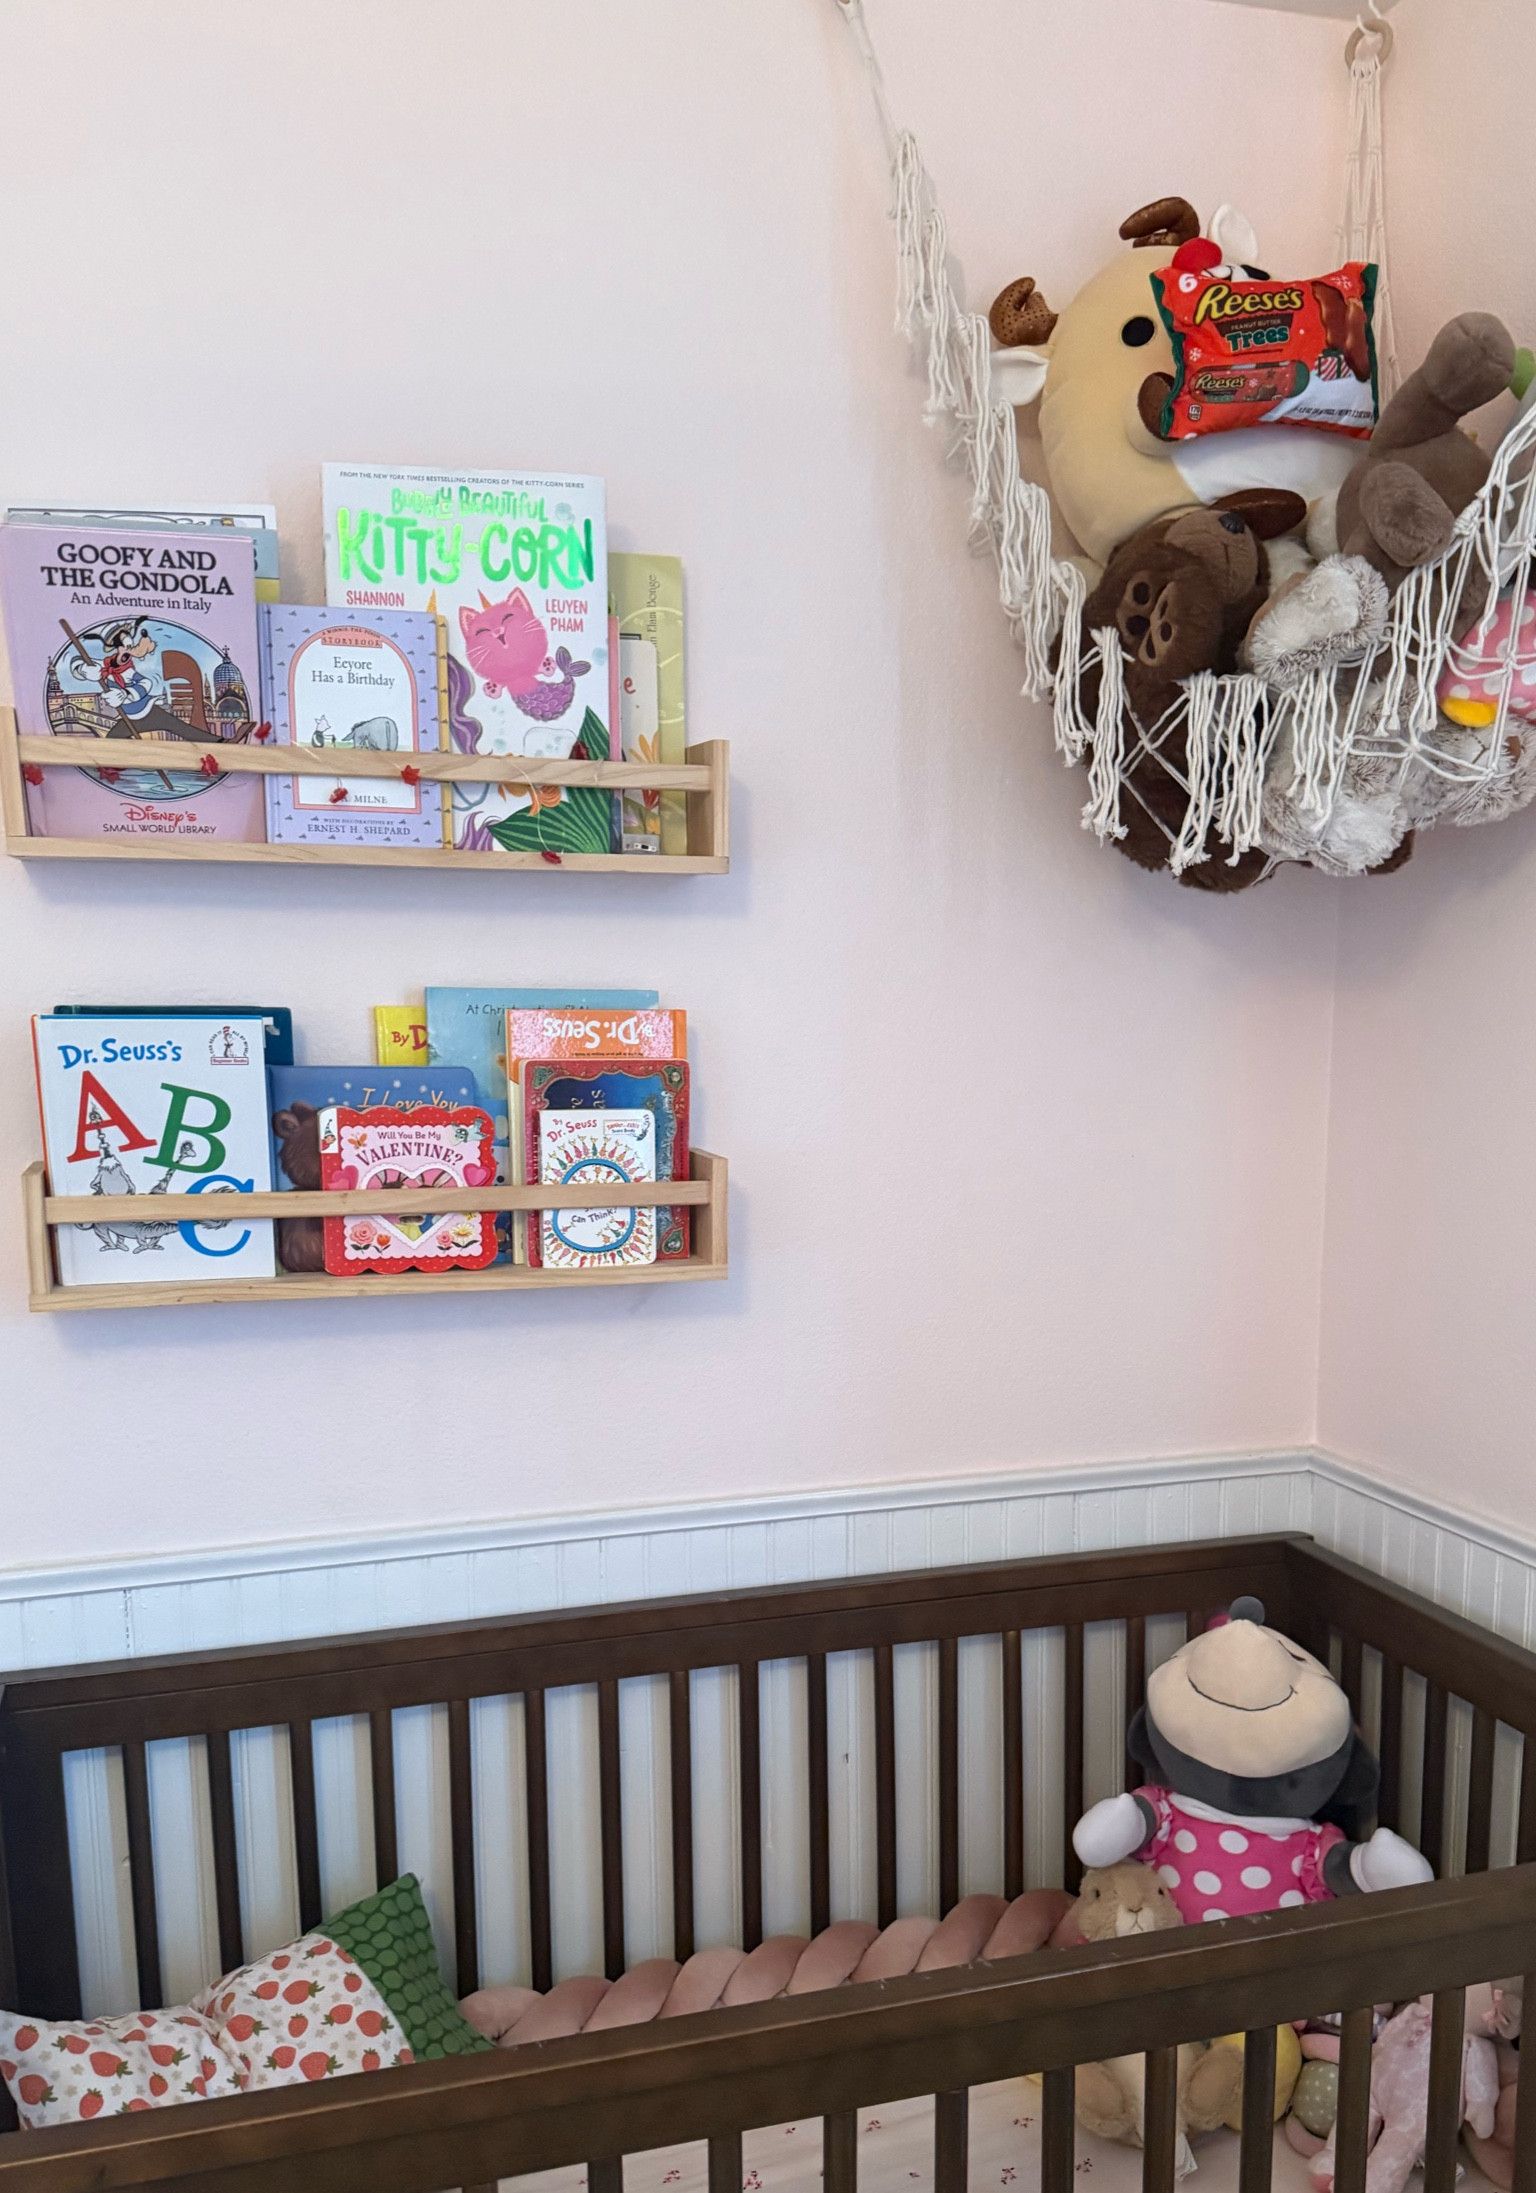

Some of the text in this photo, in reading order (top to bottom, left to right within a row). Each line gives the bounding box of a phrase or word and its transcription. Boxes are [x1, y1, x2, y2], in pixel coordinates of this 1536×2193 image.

[1178, 273, 1198, 293] 6
[1230, 319, 1282, 330] PEANUT BUTTER
[1225, 325, 1290, 353] Trees
[57, 543, 217, 571] GOOFY AND
[40, 566, 235, 596] THE GONDOLA
[70, 592, 212, 614] An Adventure in Italy
[346, 590, 405, 607] SHANNON
[545, 599, 588, 614] LEUYEN
[550, 617, 584, 632] PHAM
[322, 636, 381, 646] STORYBOOK
[333, 656, 373, 672] Eeyore
[312, 670, 396, 689] Has a Birthday
[353, 795, 388, 804] MILNE
[102, 823, 217, 834] SMALL WORLD LIBRARY
[307, 824, 347, 833] ERNEST
[363, 826, 411, 836] SHEPARD
[465, 1004, 479, 1015] At
[391, 1031, 409, 1047] By
[542, 1017, 601, 1049] Seuss
[604, 1016, 640, 1045] Dr.
[57, 1038, 182, 1069] Dr. Seuss's
[357, 1087, 376, 1108] I
[377, 1131, 441, 1141] Will You Be My
[546, 1127, 566, 1143] Dr.
[565, 1119, 598, 1134] Seuss
[355, 1142, 464, 1167] VALENTINE?
[571, 1214, 586, 1223] Can
